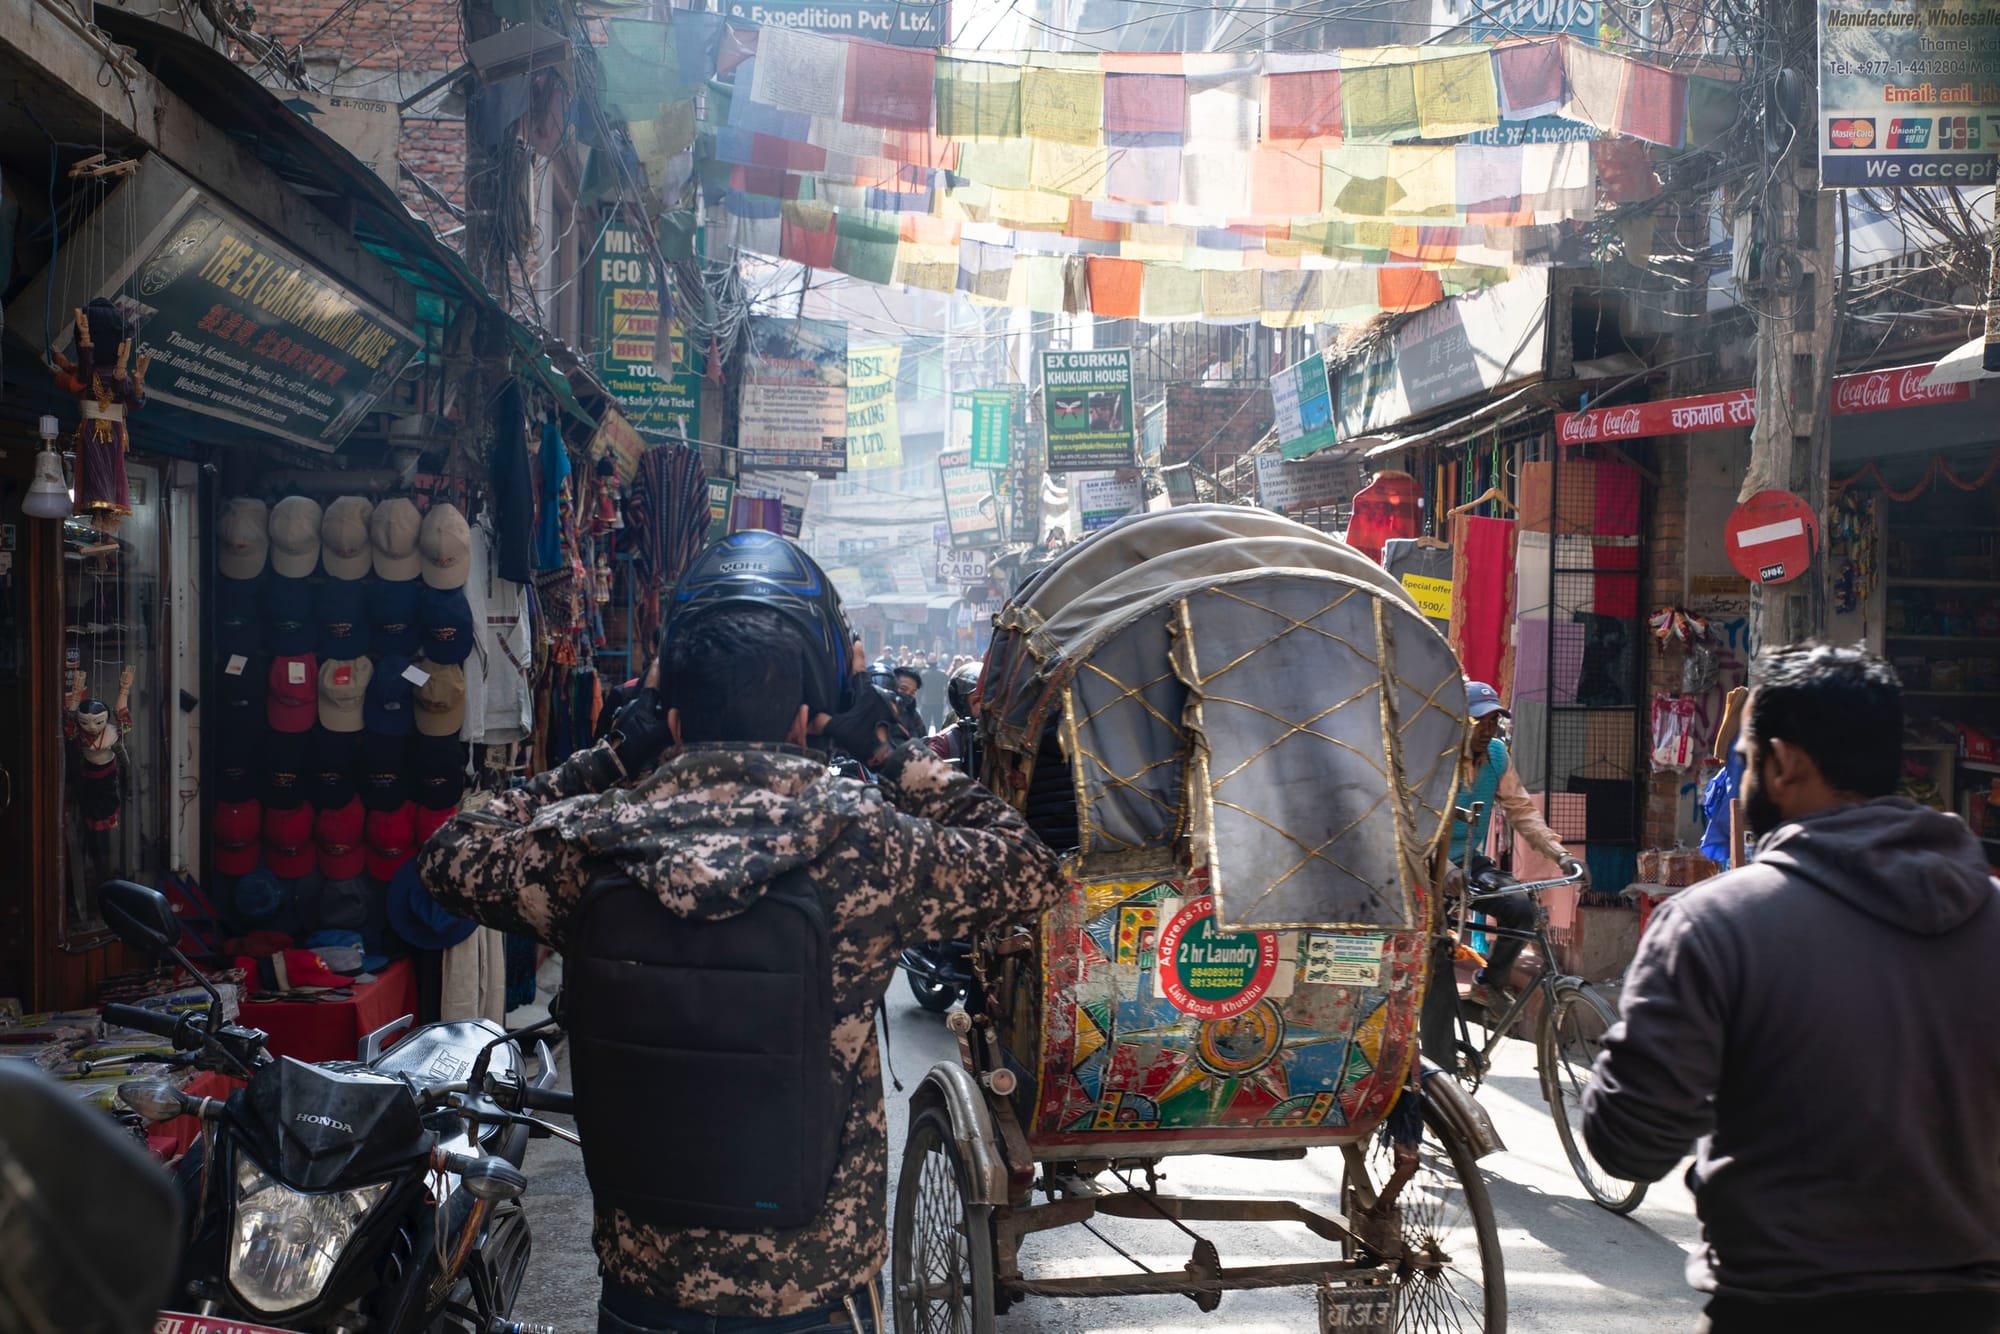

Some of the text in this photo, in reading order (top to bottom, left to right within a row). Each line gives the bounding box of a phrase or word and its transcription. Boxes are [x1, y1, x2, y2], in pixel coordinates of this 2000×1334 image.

[752, 6, 851, 30] Expedition
[858, 10, 892, 30] Pvt.
[900, 12, 936, 32] Ltd.
[1827, 9, 1922, 30] Manufacturer,
[1920, 36, 1976, 52] Thamel,
[1829, 61, 1853, 75] Tel:
[1857, 61, 1966, 75] +977-1-4412804
[1884, 83, 1937, 104] Email:
[1832, 127, 1874, 140] MasterCard
[1890, 125, 1929, 136] UnionPay
[1938, 127, 1980, 139] JCB
[1866, 159, 1993, 181] We accept
[602, 259, 641, 283] ECO
[199, 234, 254, 289] THE
[230, 248, 274, 300] EX
[253, 266, 318, 328] GURKHA
[347, 316, 398, 369] HOUSE
[166, 331, 205, 356] Thamel,
[849, 357, 882, 378] IRST
[1046, 353, 1128, 368] EX GURKHA
[174, 376, 211, 398] Website:
[1047, 369, 1129, 385] KHUKURI HOUSE
[1837, 373, 1891, 409] Coca-Cola
[670, 398, 695, 409] Ticket
[1562, 414, 1598, 441] Coca-Cola
[1602, 408, 1640, 436] Coca-Cola
[862, 432, 887, 455] LTD.
[940, 454, 970, 467] MOB
[1014, 441, 1026, 528] HIMALAYAN
[947, 551, 974, 564] SIM
[940, 563, 984, 577] CARD
[1402, 580, 1452, 594] Special offer
[1180, 943, 1258, 969] 2 hr Laundry
[1263, 934, 1276, 967] Park
[1168, 983, 1186, 1007] Link
[1221, 985, 1262, 1013] Khusibu
[295, 1112, 354, 1134] HONDA
